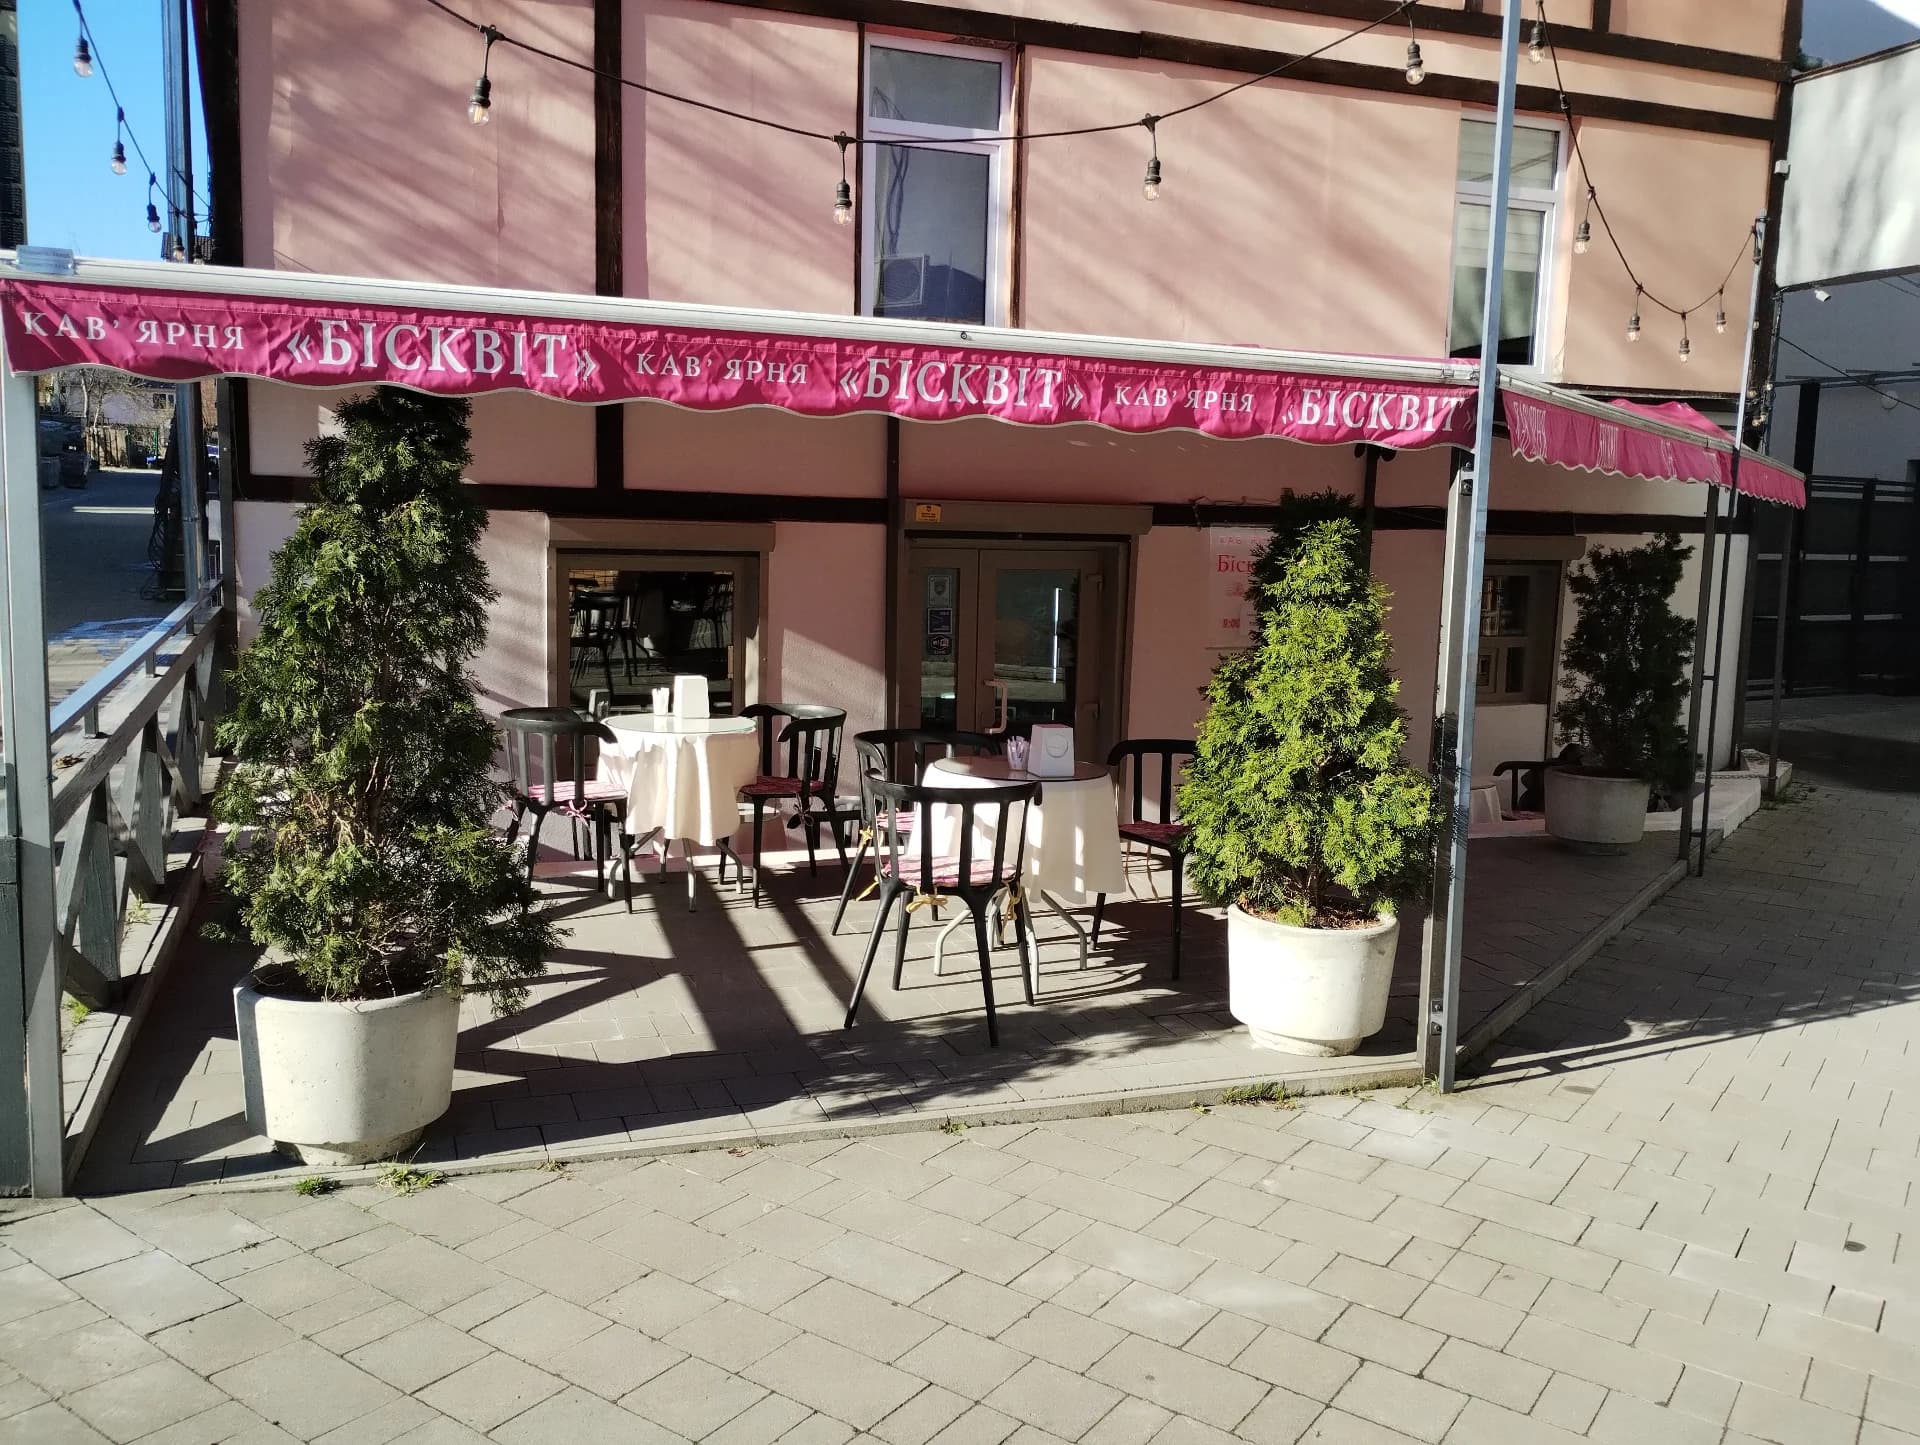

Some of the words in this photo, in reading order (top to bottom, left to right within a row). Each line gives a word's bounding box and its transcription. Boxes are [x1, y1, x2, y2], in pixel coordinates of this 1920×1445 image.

[286, 318, 597, 381] «БІСКВІТ»
[840, 357, 1084, 409] «БІСКВІТ»
[1217, 554, 1256, 573] Біск
